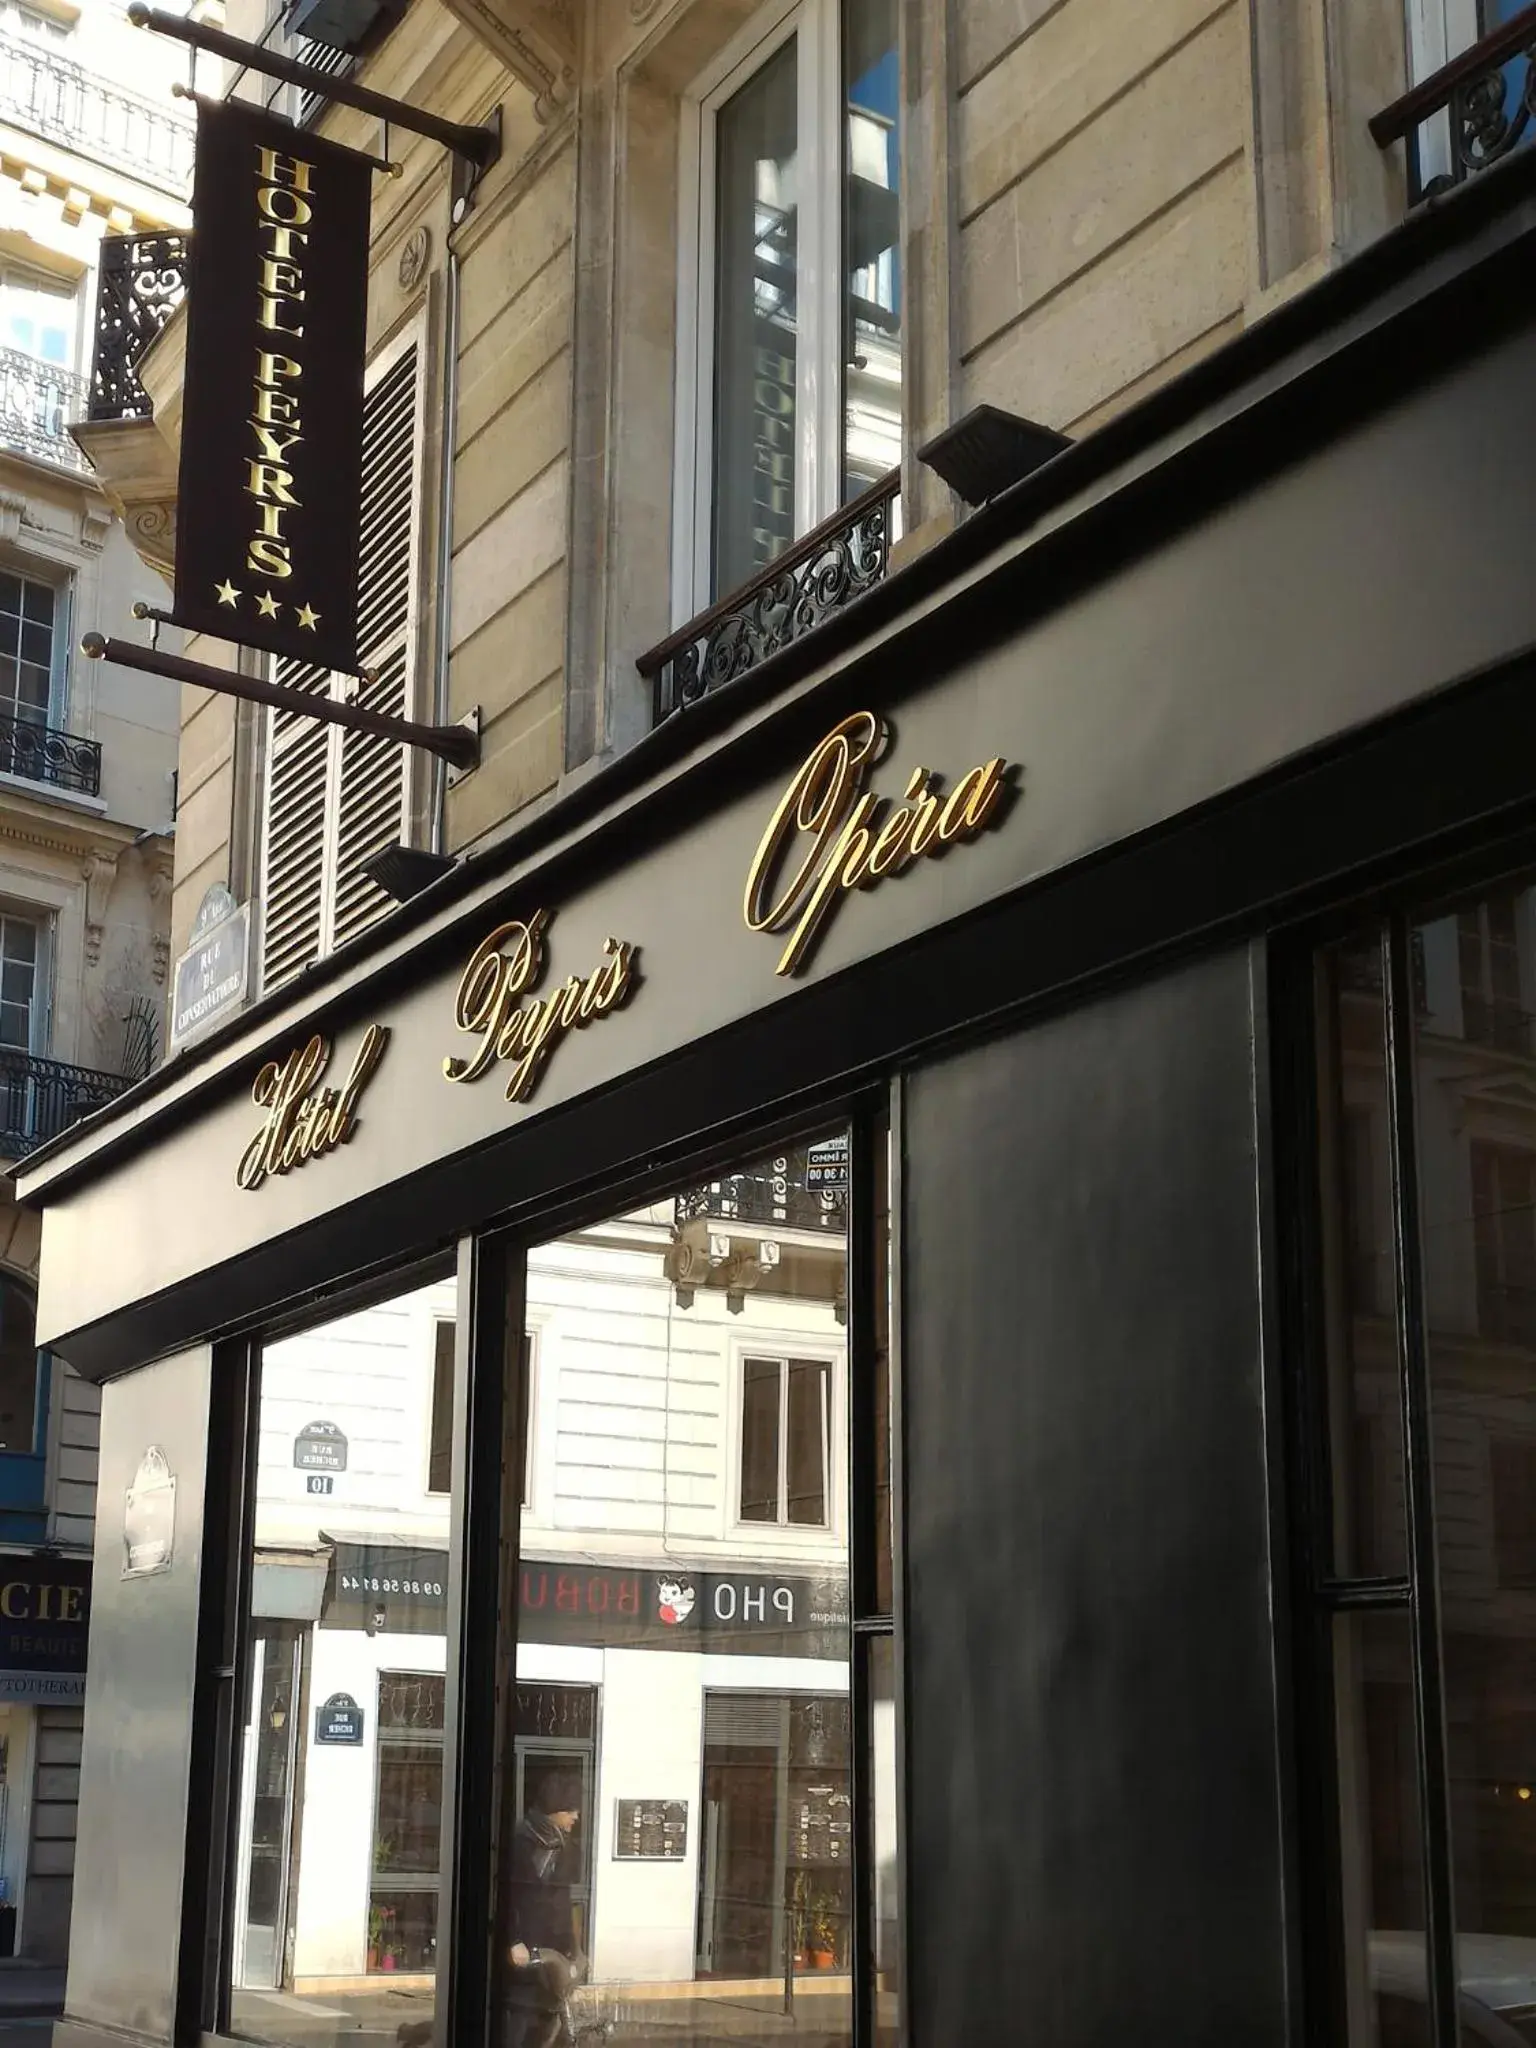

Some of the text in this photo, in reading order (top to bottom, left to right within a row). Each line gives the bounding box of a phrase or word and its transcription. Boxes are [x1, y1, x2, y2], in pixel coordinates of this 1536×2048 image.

[243, 143, 317, 579] HOTEL PEYRIS
[200, 941, 221, 970] RUE
[236, 709, 1012, 1191] Hôtel Peyris Opéra
